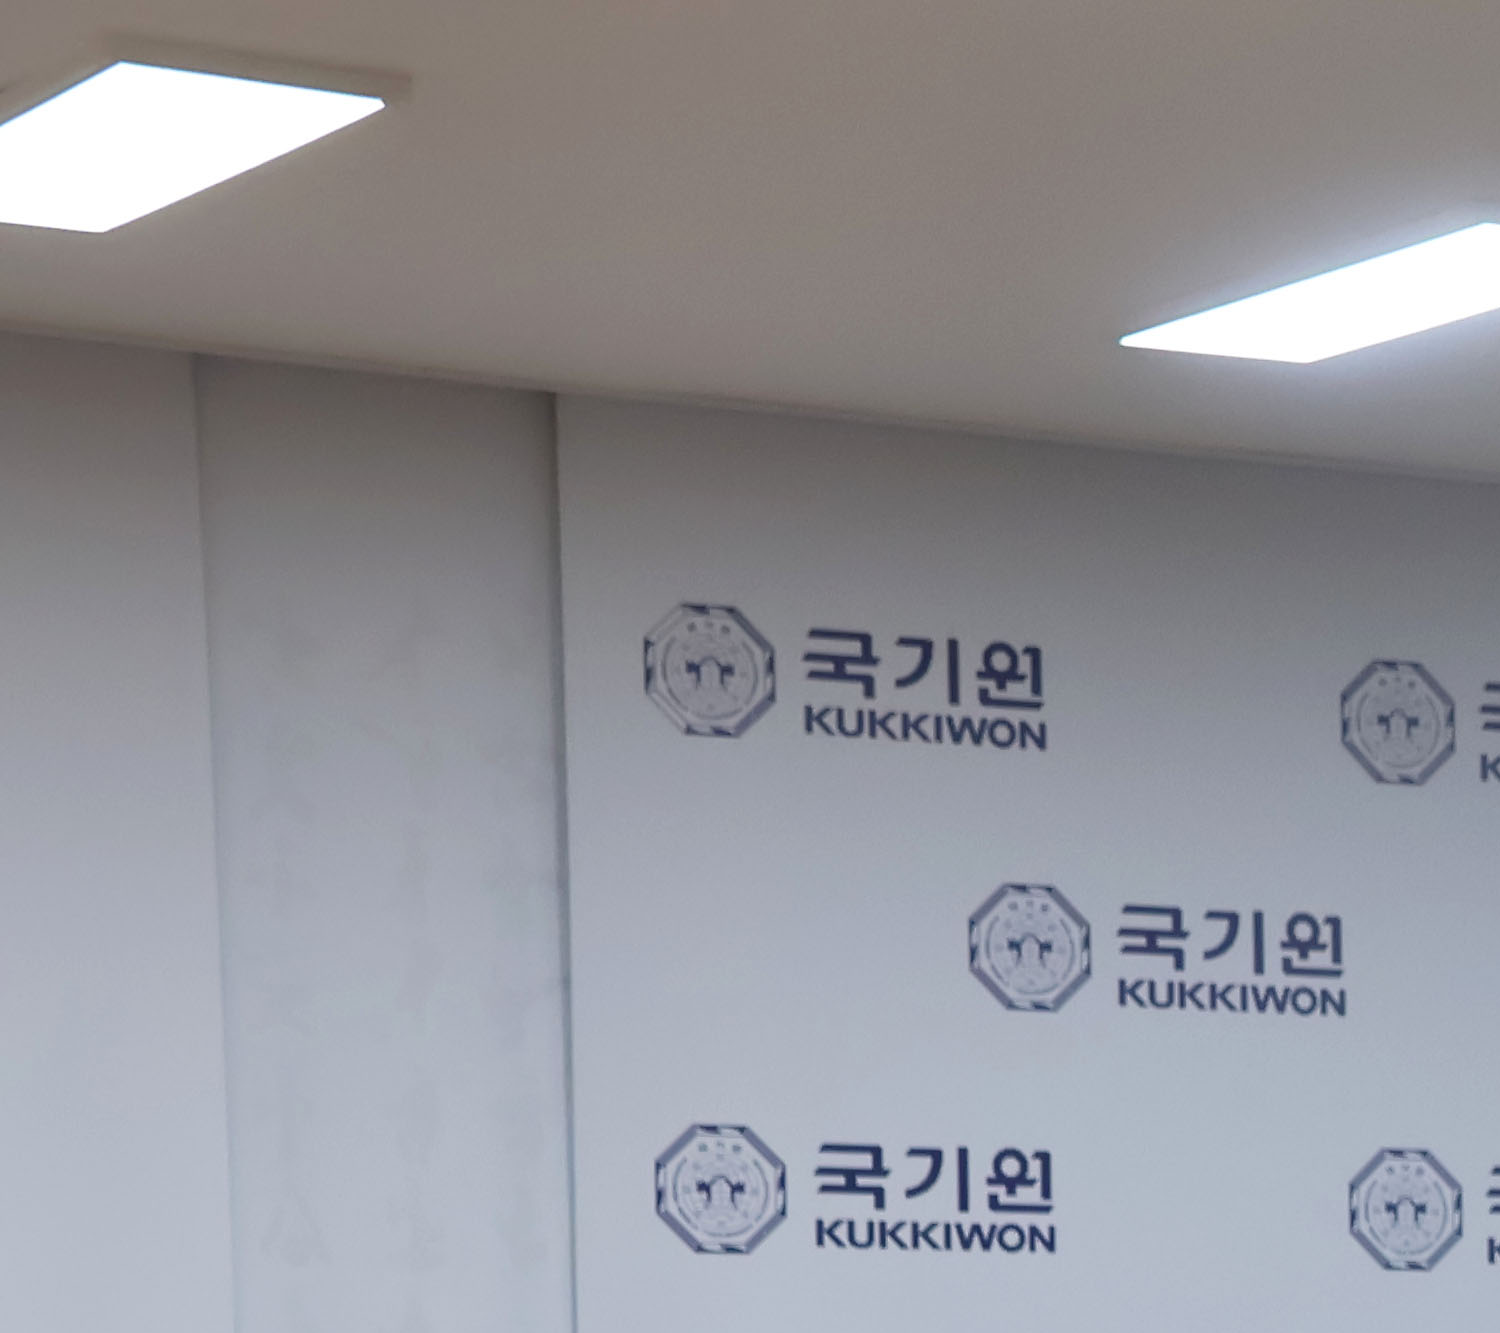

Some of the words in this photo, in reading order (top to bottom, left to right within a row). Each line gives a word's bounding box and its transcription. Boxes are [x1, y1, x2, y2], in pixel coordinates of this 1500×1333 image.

[803, 628, 1046, 709] 국기원
[804, 704, 1047, 752] KUKKIWON
[1117, 904, 1345, 978] 국기원
[1118, 977, 1347, 1017] KUKKIWON
[814, 1142, 1054, 1214] 국기원
[815, 1216, 1057, 1255] KUKKIWON
